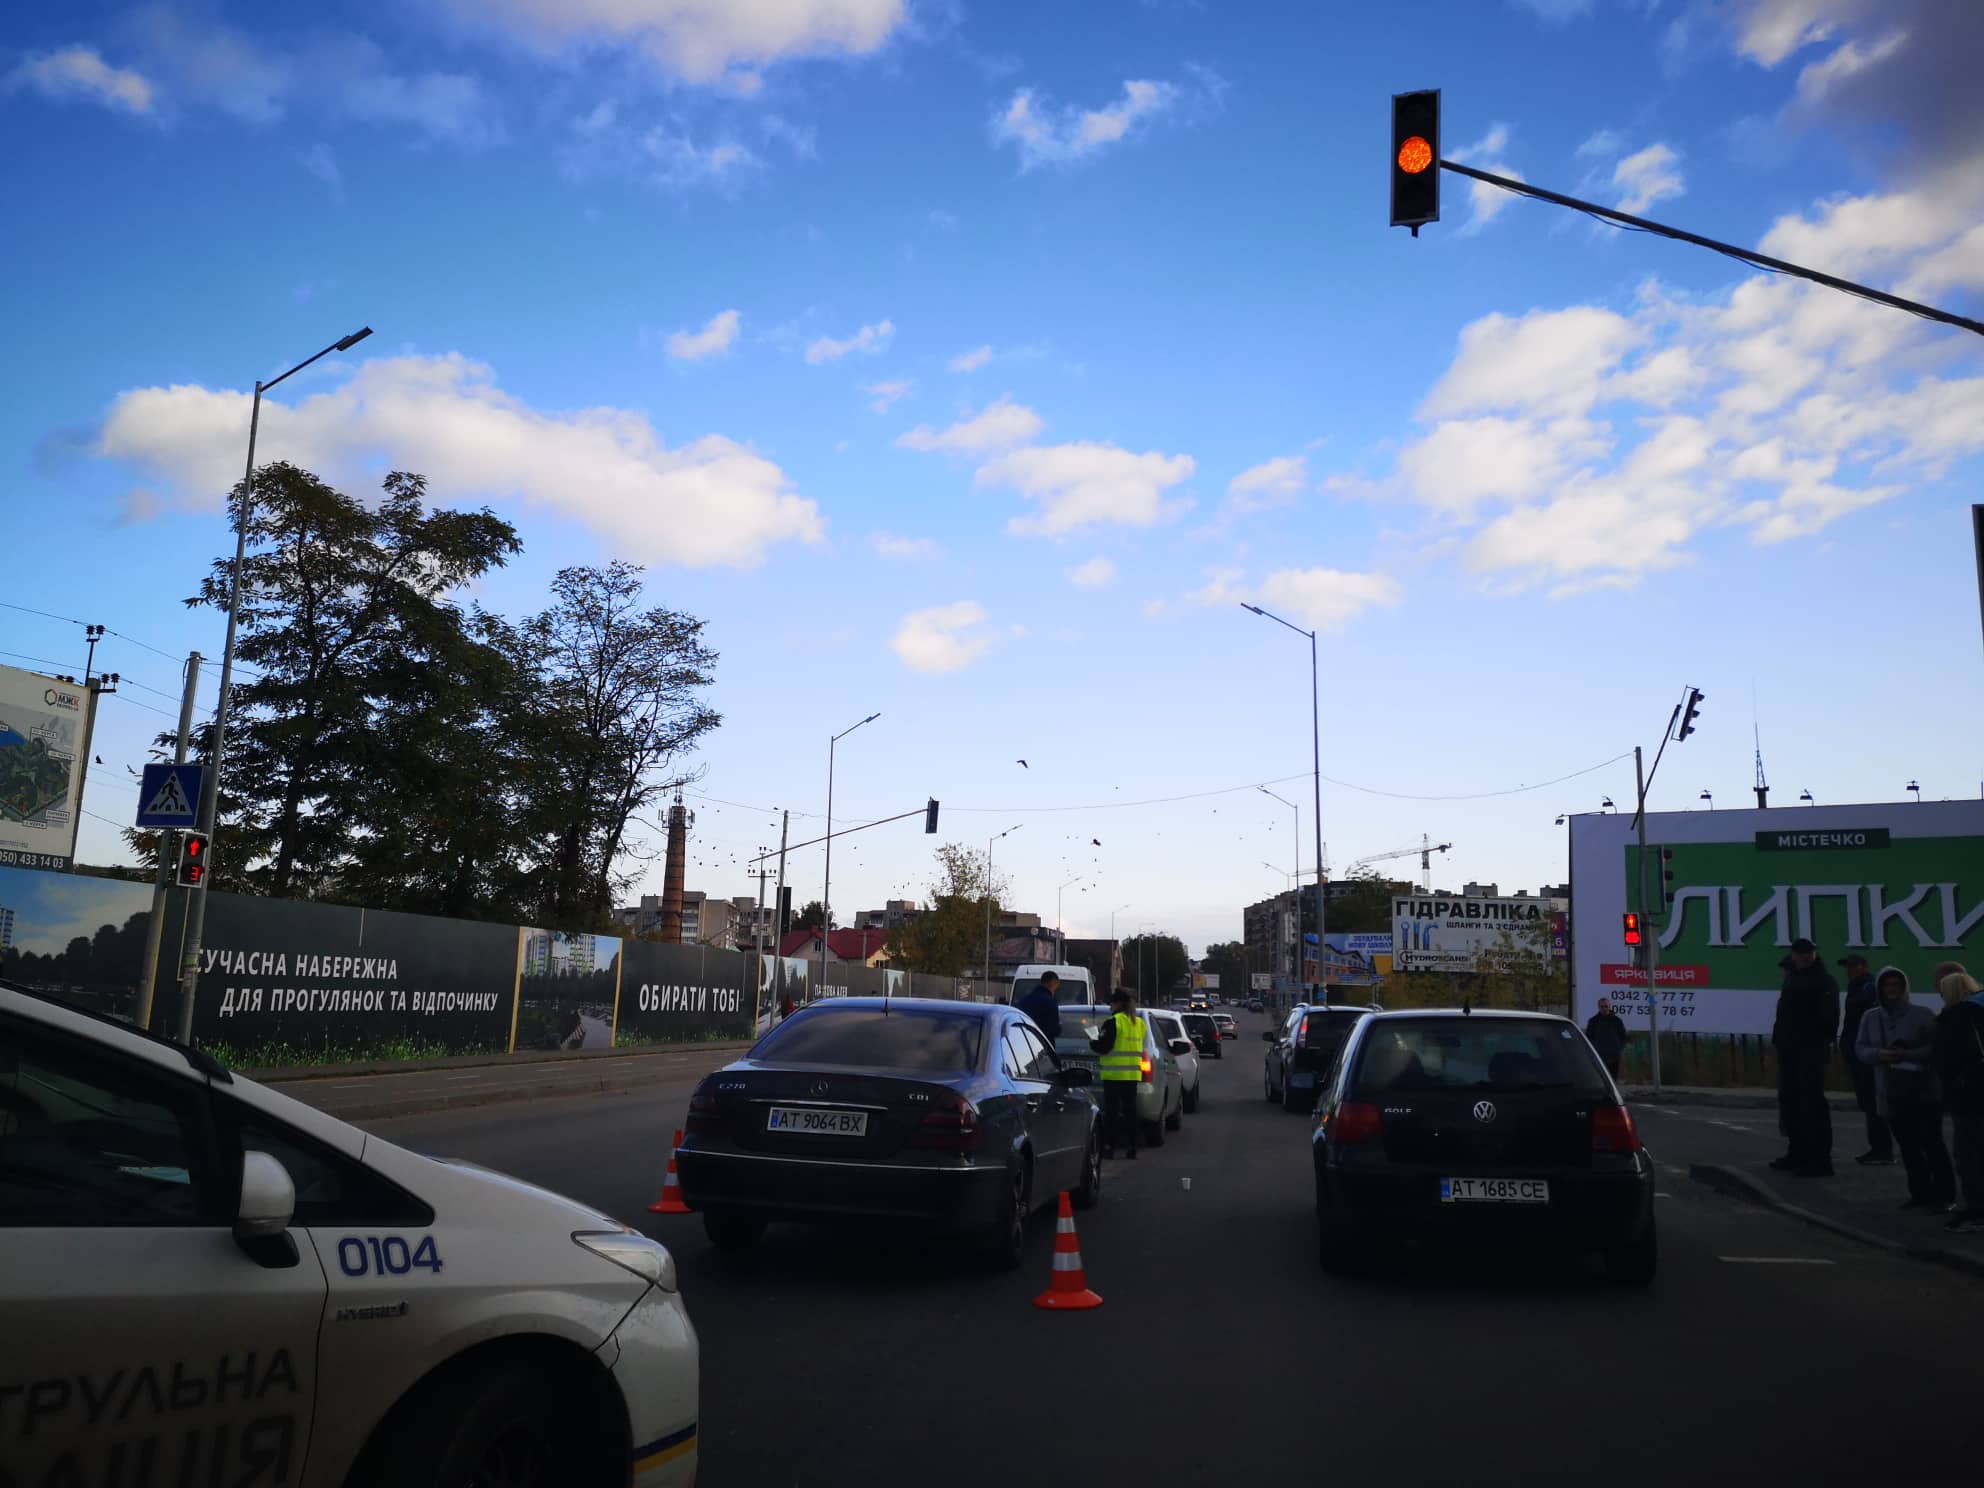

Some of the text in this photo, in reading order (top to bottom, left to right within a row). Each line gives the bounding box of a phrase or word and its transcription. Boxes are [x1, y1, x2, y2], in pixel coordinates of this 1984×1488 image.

[1777, 833, 1867, 848] МІСТЕЧКО
[20, 853, 37, 866] 433
[40, 856, 51, 867] 14
[52, 857, 64, 869] 03
[1396, 901, 1542, 920] ГІДРАВЛІКА
[1446, 922, 1481, 930] ШЛАНГИ
[1483, 922, 1494, 930] ТА
[295, 953, 398, 980] НАБЕРЕЖНА
[219, 987, 499, 1018] ДЛЯ ПРОГУЛЯНОК ТА ВІДПОЧИНКУ
[639, 983, 741, 1013] ОБИРАТИ ТОБІ
[1611, 990, 1640, 1001] 0342
[1662, 991, 1676, 1001] 77
[1680, 992, 1695, 1002] 77
[1612, 1004, 1696, 1016] 067 53 78 67
[778, 1111, 862, 1132] AT 9064 BX
[1452, 1180, 1545, 1199] AT 1685 CE
[338, 1235, 443, 1277] 0104
